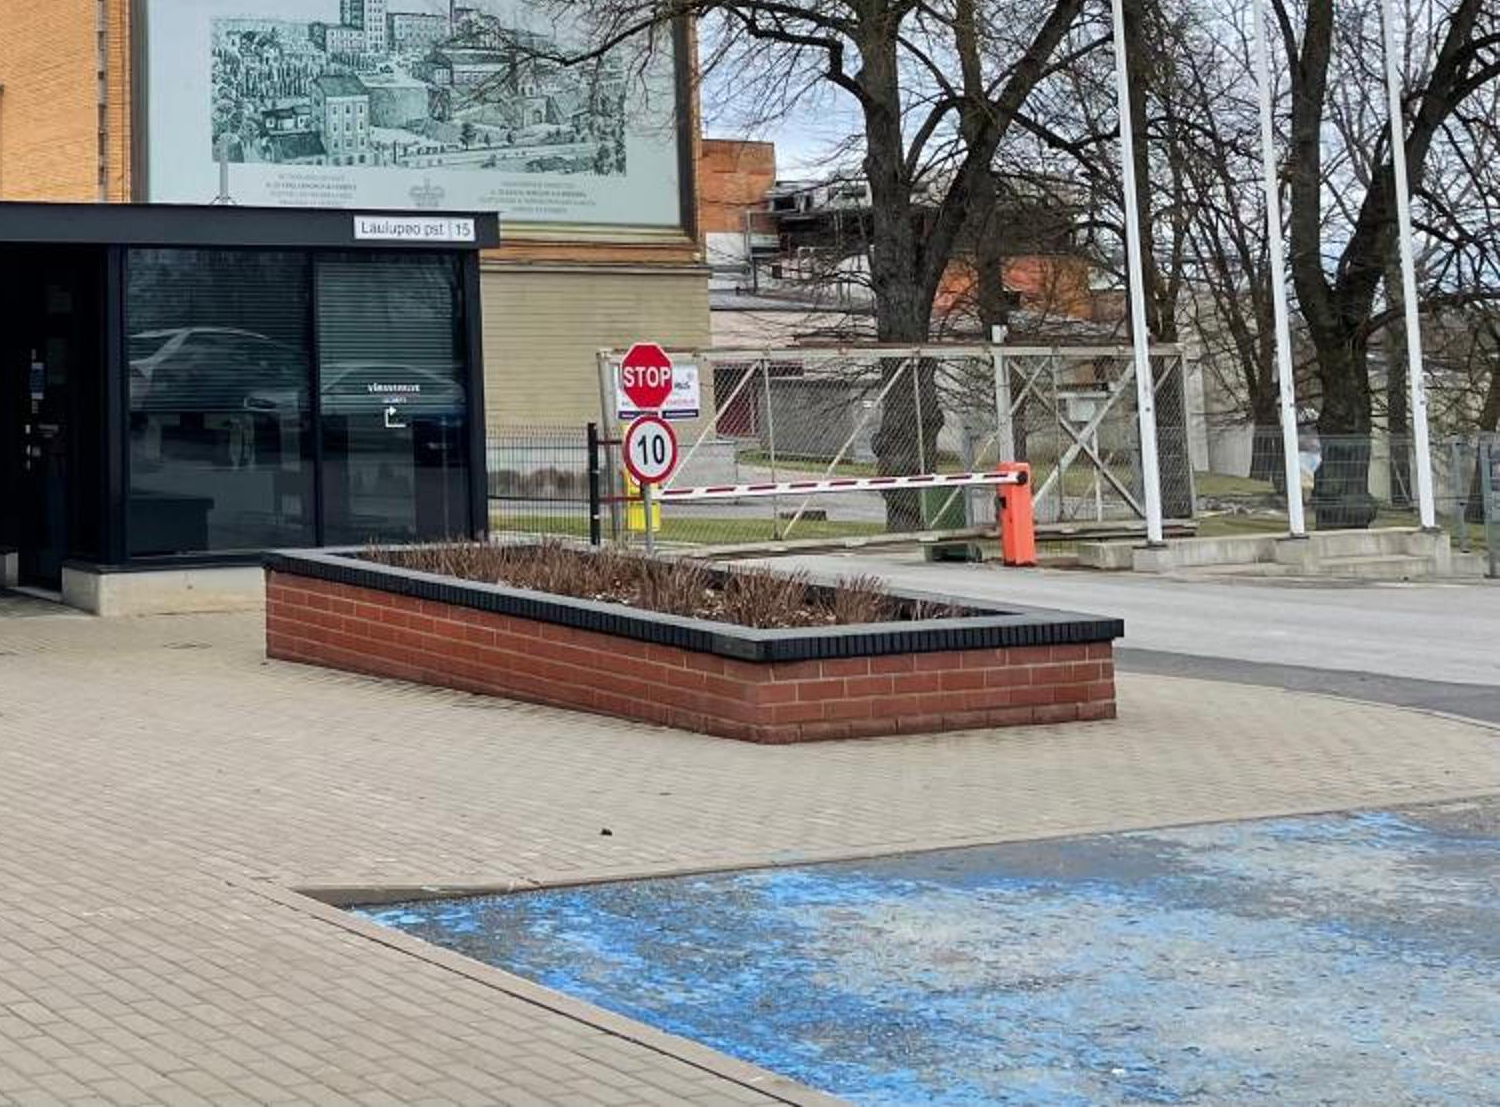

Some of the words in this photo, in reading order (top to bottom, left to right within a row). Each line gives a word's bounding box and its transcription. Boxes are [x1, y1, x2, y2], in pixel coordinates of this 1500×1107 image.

[424, 222, 445, 237] pst
[455, 223, 471, 237] 15
[623, 366, 671, 388] STOP
[637, 434, 665, 466] 10
